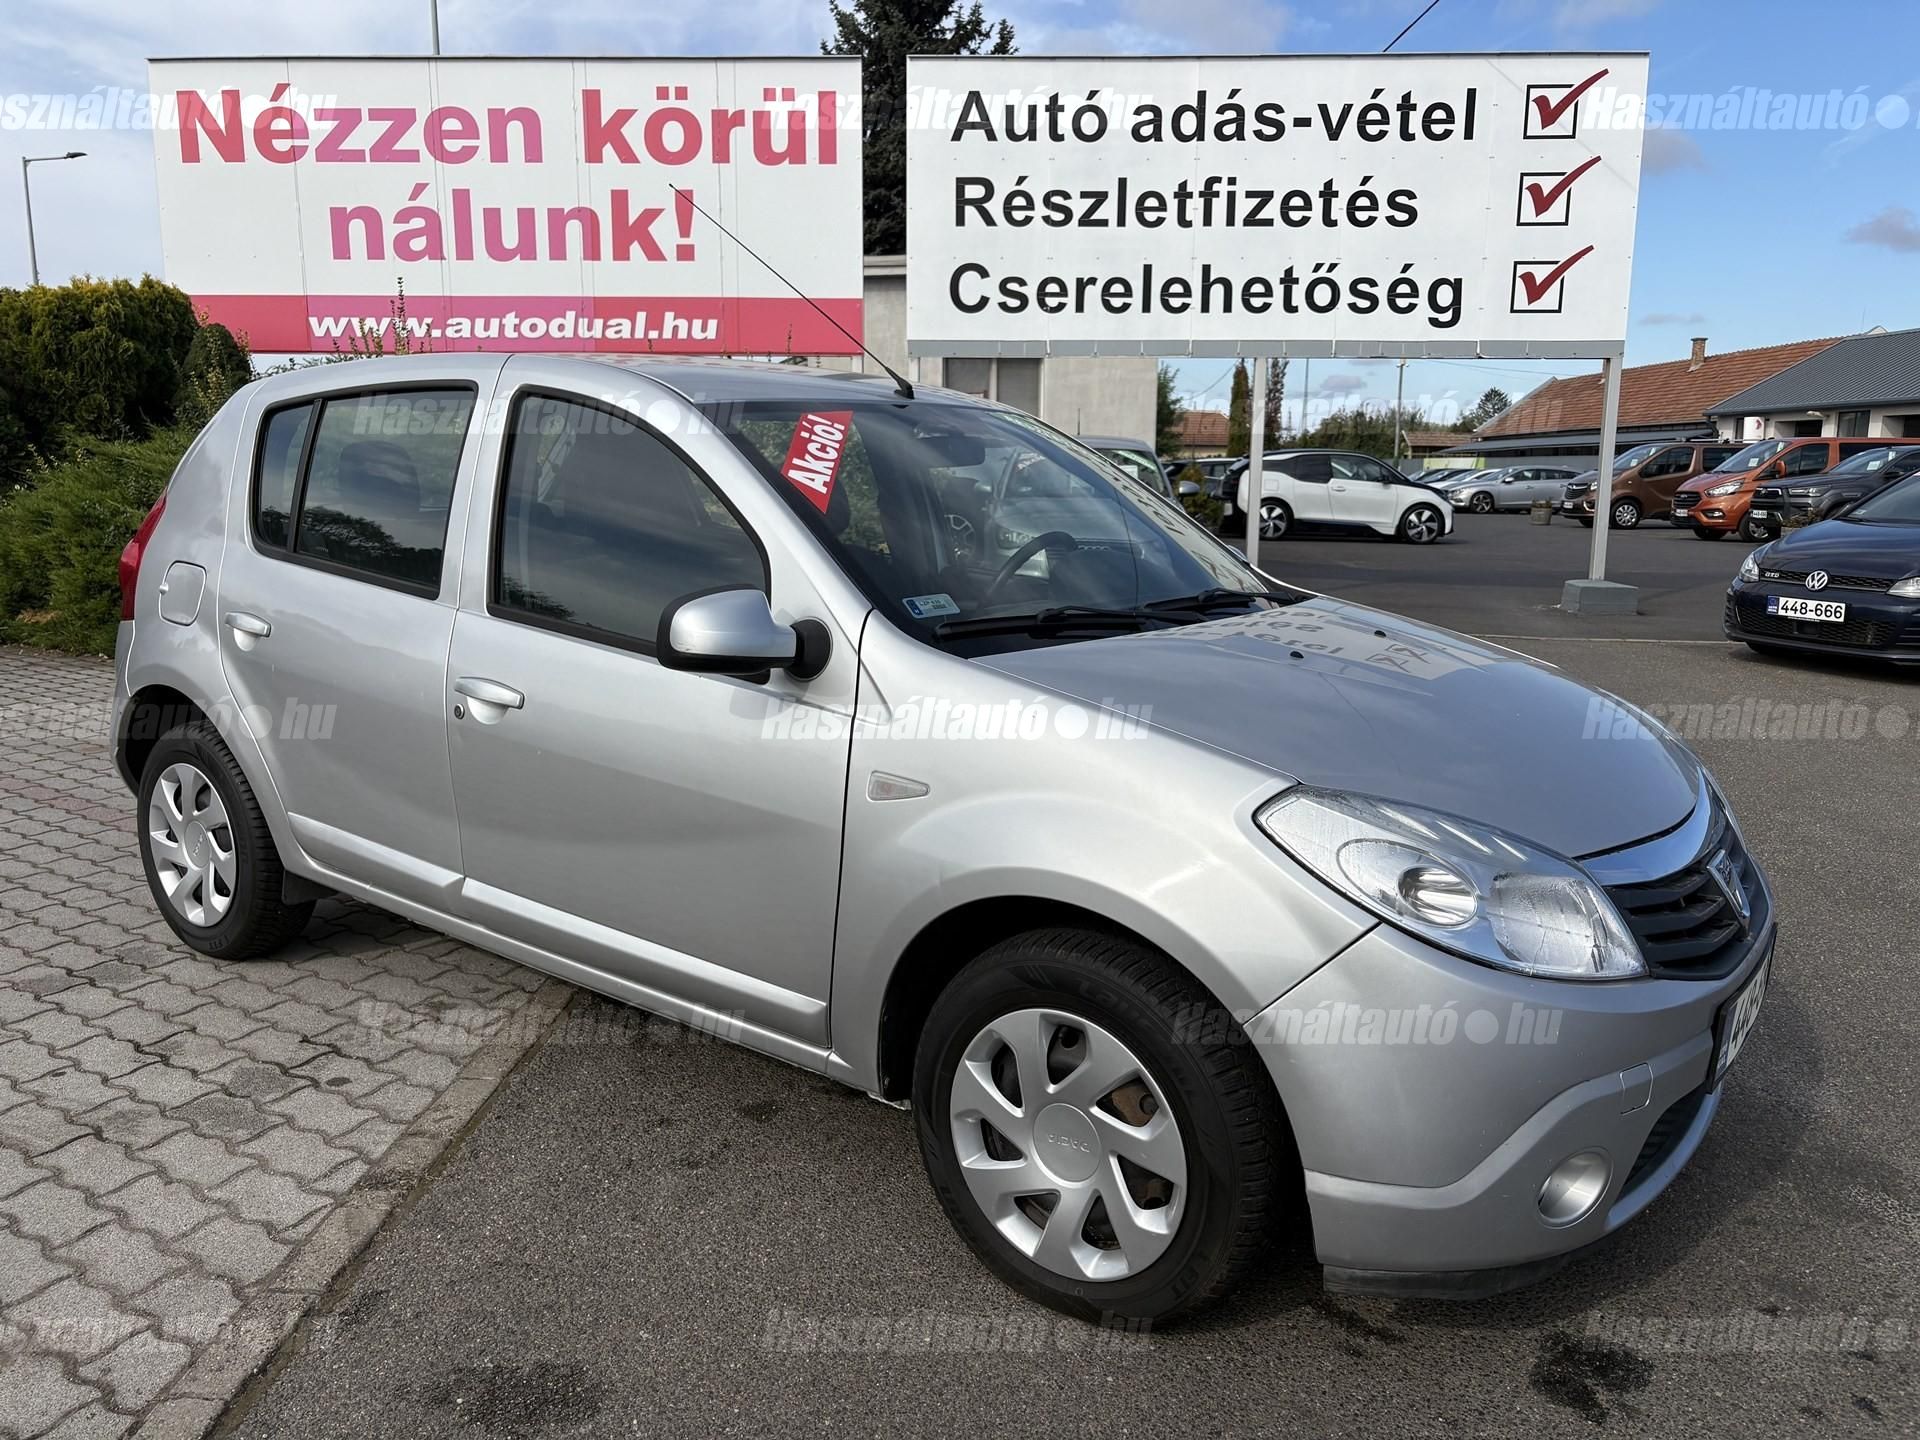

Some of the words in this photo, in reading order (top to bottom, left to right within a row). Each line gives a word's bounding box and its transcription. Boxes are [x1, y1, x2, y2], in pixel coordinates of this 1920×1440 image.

[177, 84, 542, 164] Nézzen
[583, 87, 838, 166] körül
[951, 90, 1107, 143] Autó
[1132, 88, 1476, 143] adás-vétel
[331, 183, 696, 262] nálunk!
[955, 176, 1418, 228] Részletfizetés
[308, 310, 718, 340] www.autodual.hu
[950, 263, 1463, 329] Cserelehetőség
[787, 414, 846, 495] Akció!
[1781, 599, 1843, 619] 448-666
